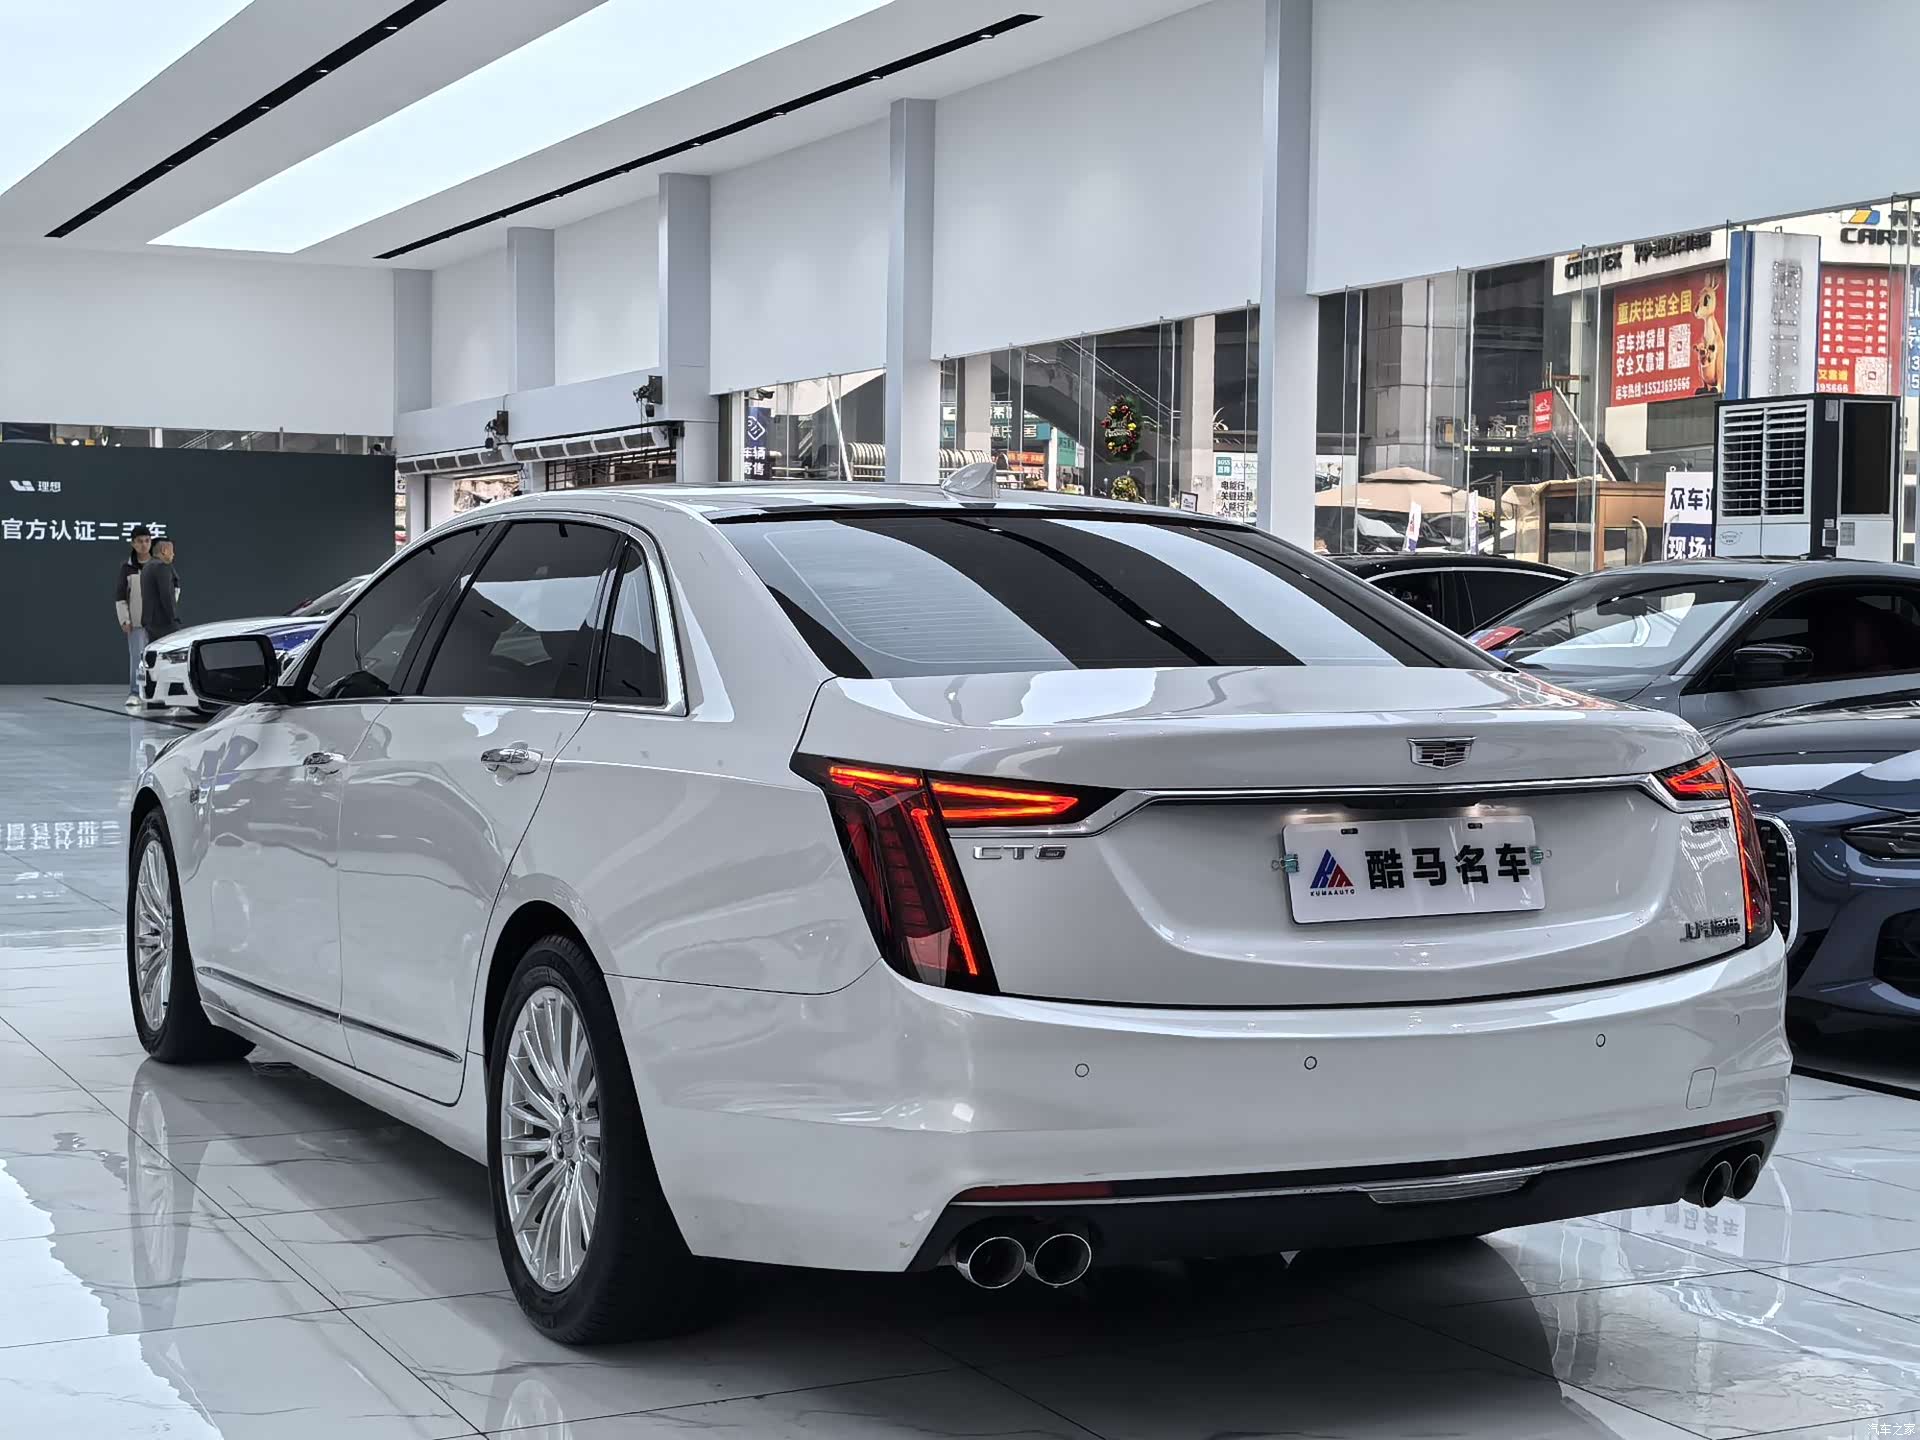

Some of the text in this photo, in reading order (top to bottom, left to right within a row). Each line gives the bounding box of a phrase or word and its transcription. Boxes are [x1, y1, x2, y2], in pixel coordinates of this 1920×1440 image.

[1617, 290, 1692, 325] 重庆往返全国
[1616, 327, 1665, 355] 运车找袋鼠
[1616, 350, 1665, 377] 安全又靠谱
[38, 480, 62, 493] 理想
[1668, 535, 1712, 560] 现场
[973, 844, 1067, 860] CT6
[1364, 843, 1530, 889] 酷马名车
[1310, 889, 1356, 897] KUMAAUTO
